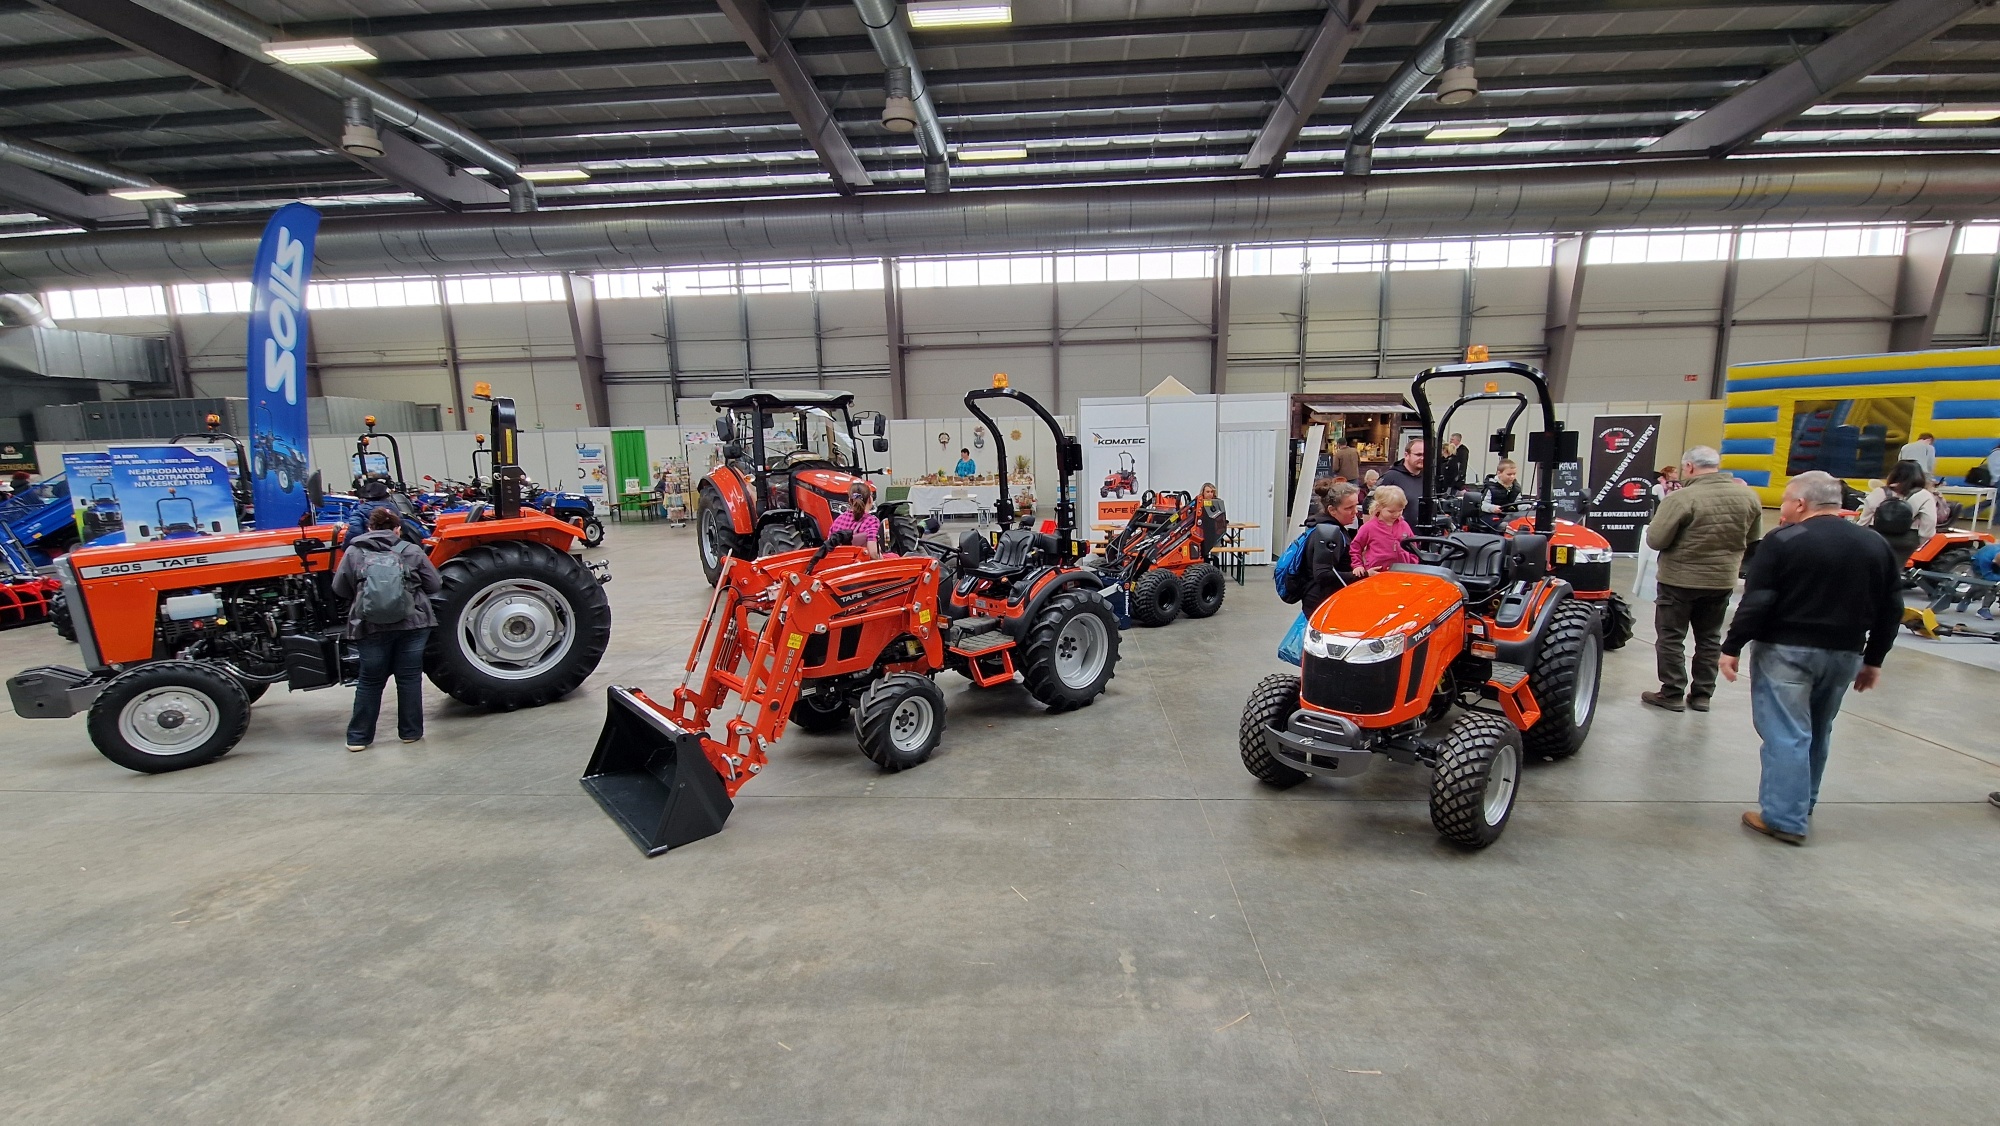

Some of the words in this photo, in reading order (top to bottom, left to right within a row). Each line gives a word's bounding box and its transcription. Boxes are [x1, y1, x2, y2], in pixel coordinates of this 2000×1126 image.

[1097, 437, 1146, 446] KOMATEC
[128, 465, 214, 476] NEJPRODÁVANĚJŠÍ
[1592, 481, 1614, 506] PRVNÍ
[1609, 452, 1635, 483] MASOVÉ
[1632, 424, 1656, 454] CHIPSY
[138, 473, 207, 482] MALOTRAKTOR
[150, 479, 187, 487] ČESKÉM
[156, 556, 209, 568] TAFE
[101, 564, 130, 575] 240
[840, 592, 864, 603] TAFE
[1413, 626, 1432, 642] TAFE
[775, 678, 786, 693] TL
